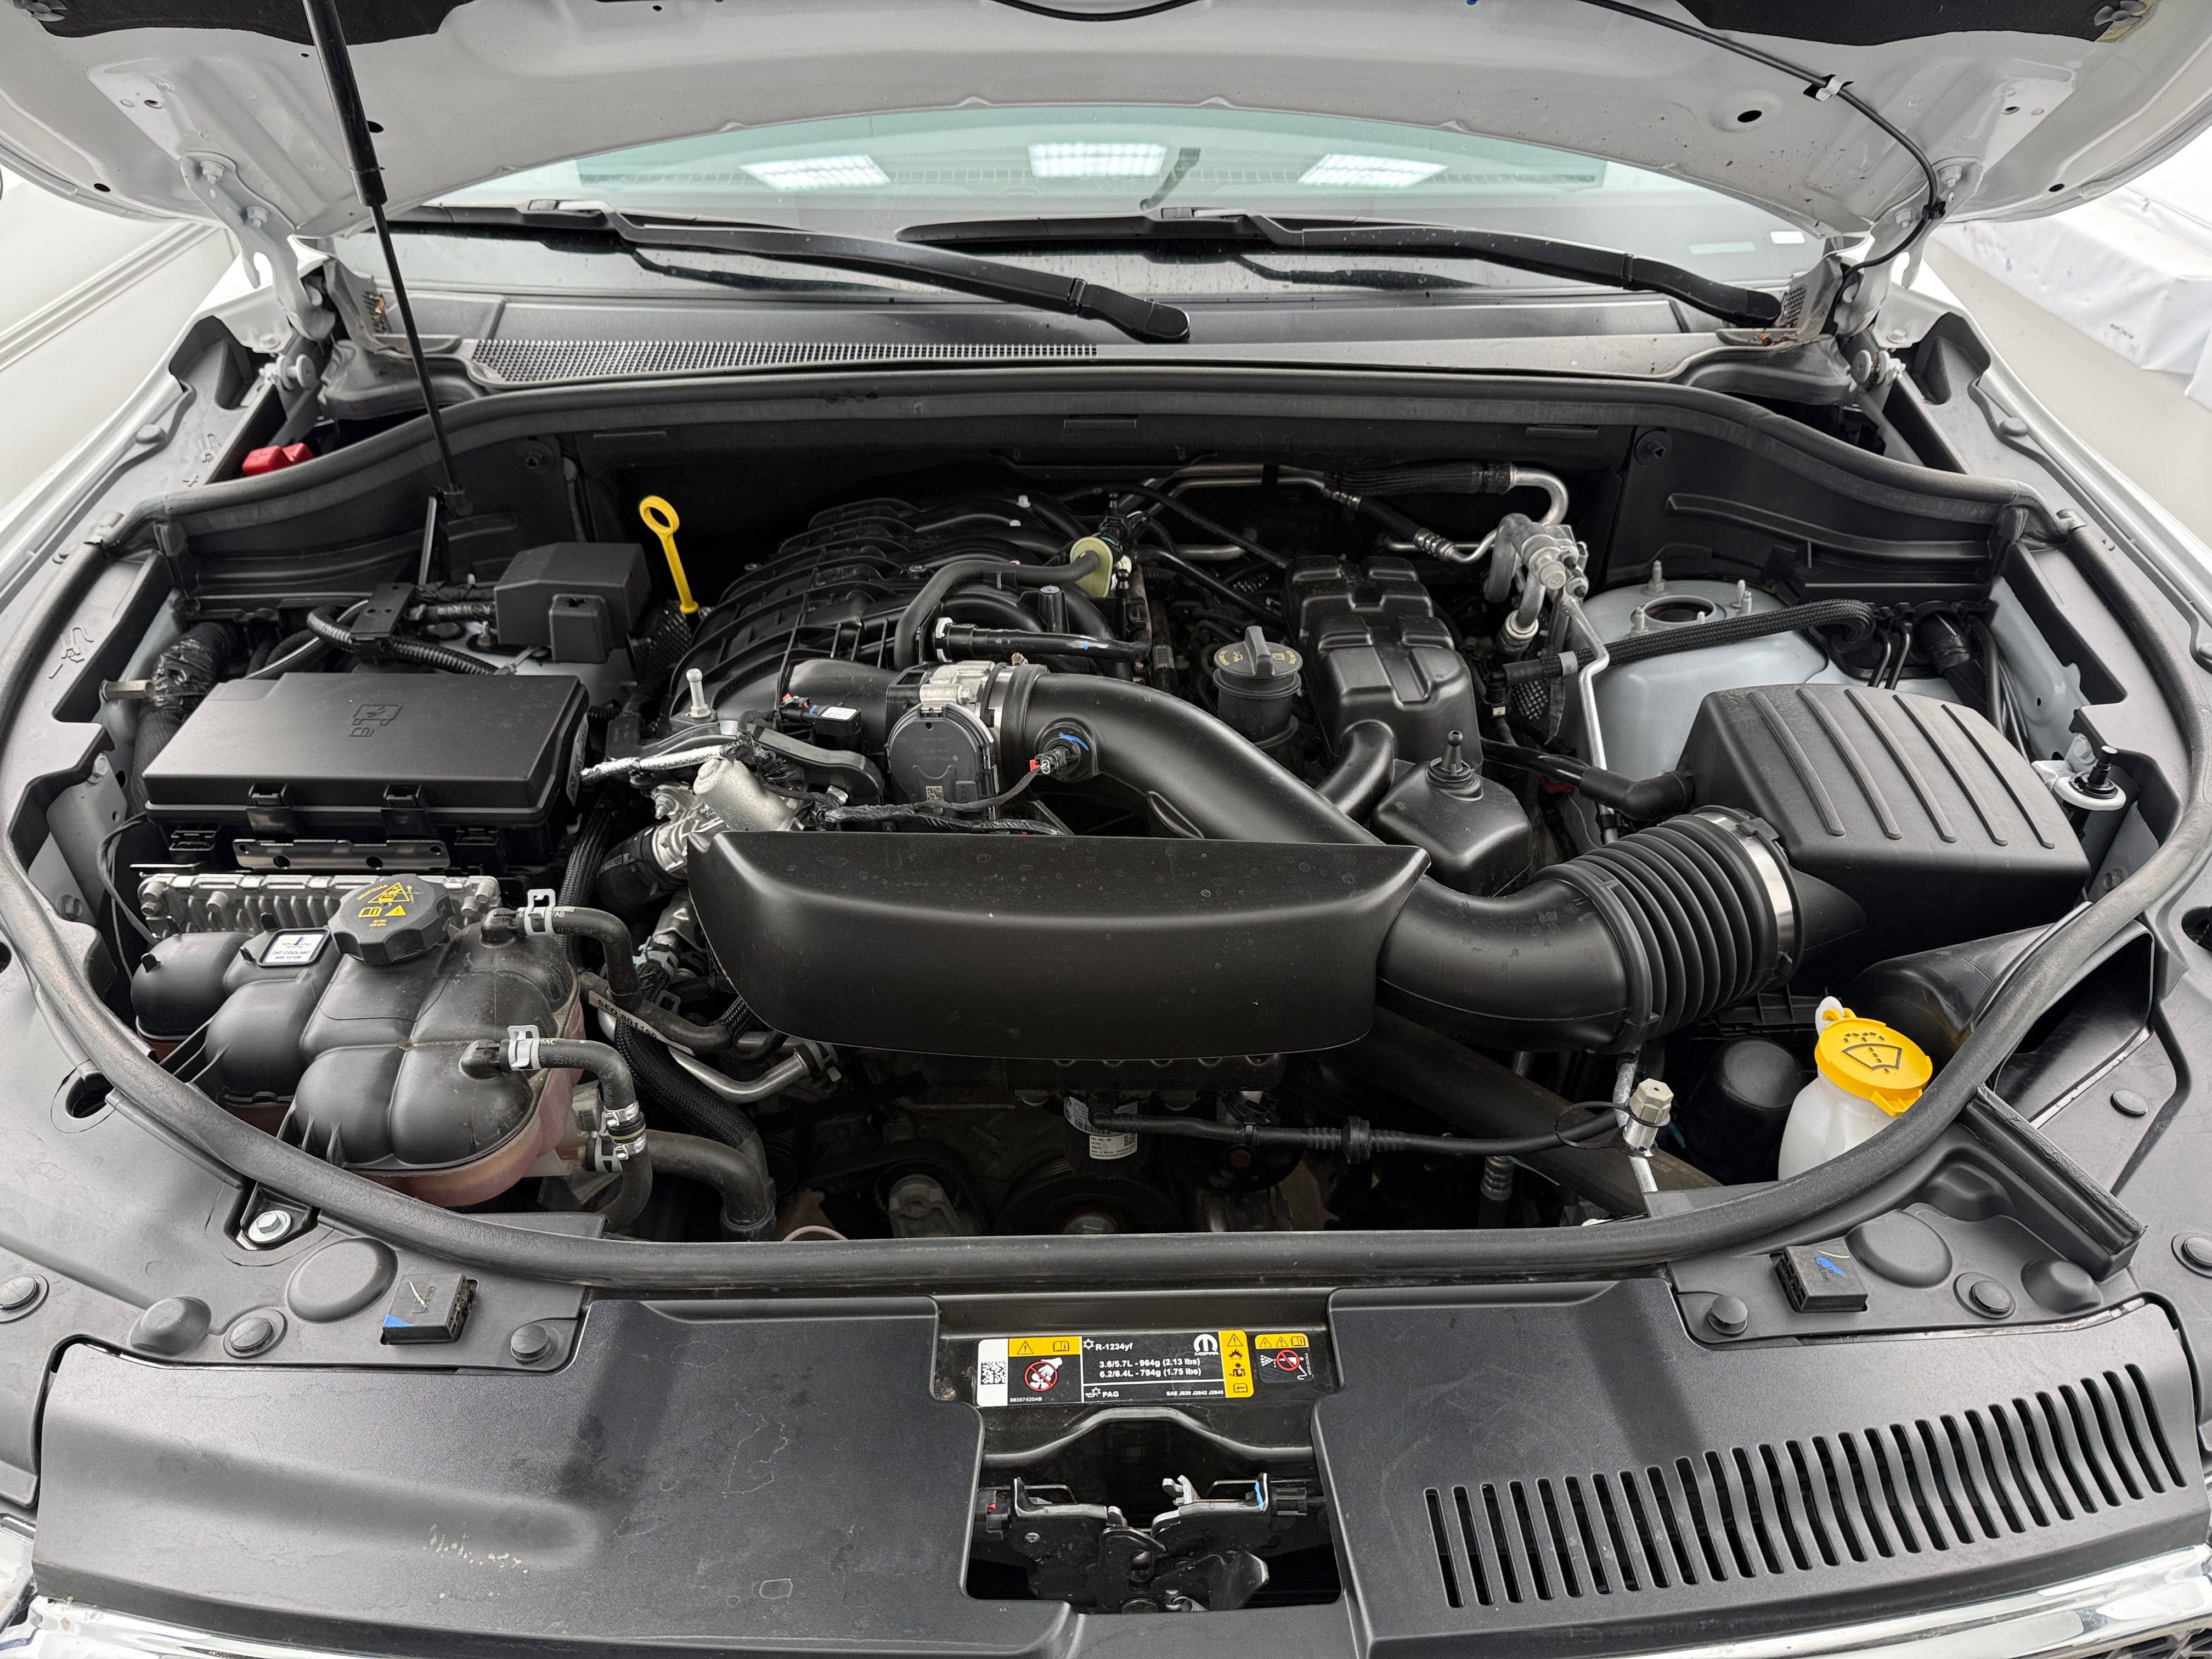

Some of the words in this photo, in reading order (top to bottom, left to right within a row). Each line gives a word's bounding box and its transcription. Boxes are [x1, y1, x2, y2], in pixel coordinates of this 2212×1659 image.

[1095, 1342, 1133, 1351] R-1234yf
[1099, 1359, 1133, 1368] 3.6/5.7L
[1139, 1359, 1160, 1367] 964g
[1163, 1358, 1183, 1367] (2.13
[1184, 1358, 1200, 1367] lbs)
[1099, 1369, 1134, 1379] 6.2/6.4L
[1141, 1368, 1161, 1377] 794g
[1163, 1368, 1183, 1377] (1.75
[1185, 1367, 1201, 1376] lbs)
[1102, 1390, 1119, 1398] PAG
